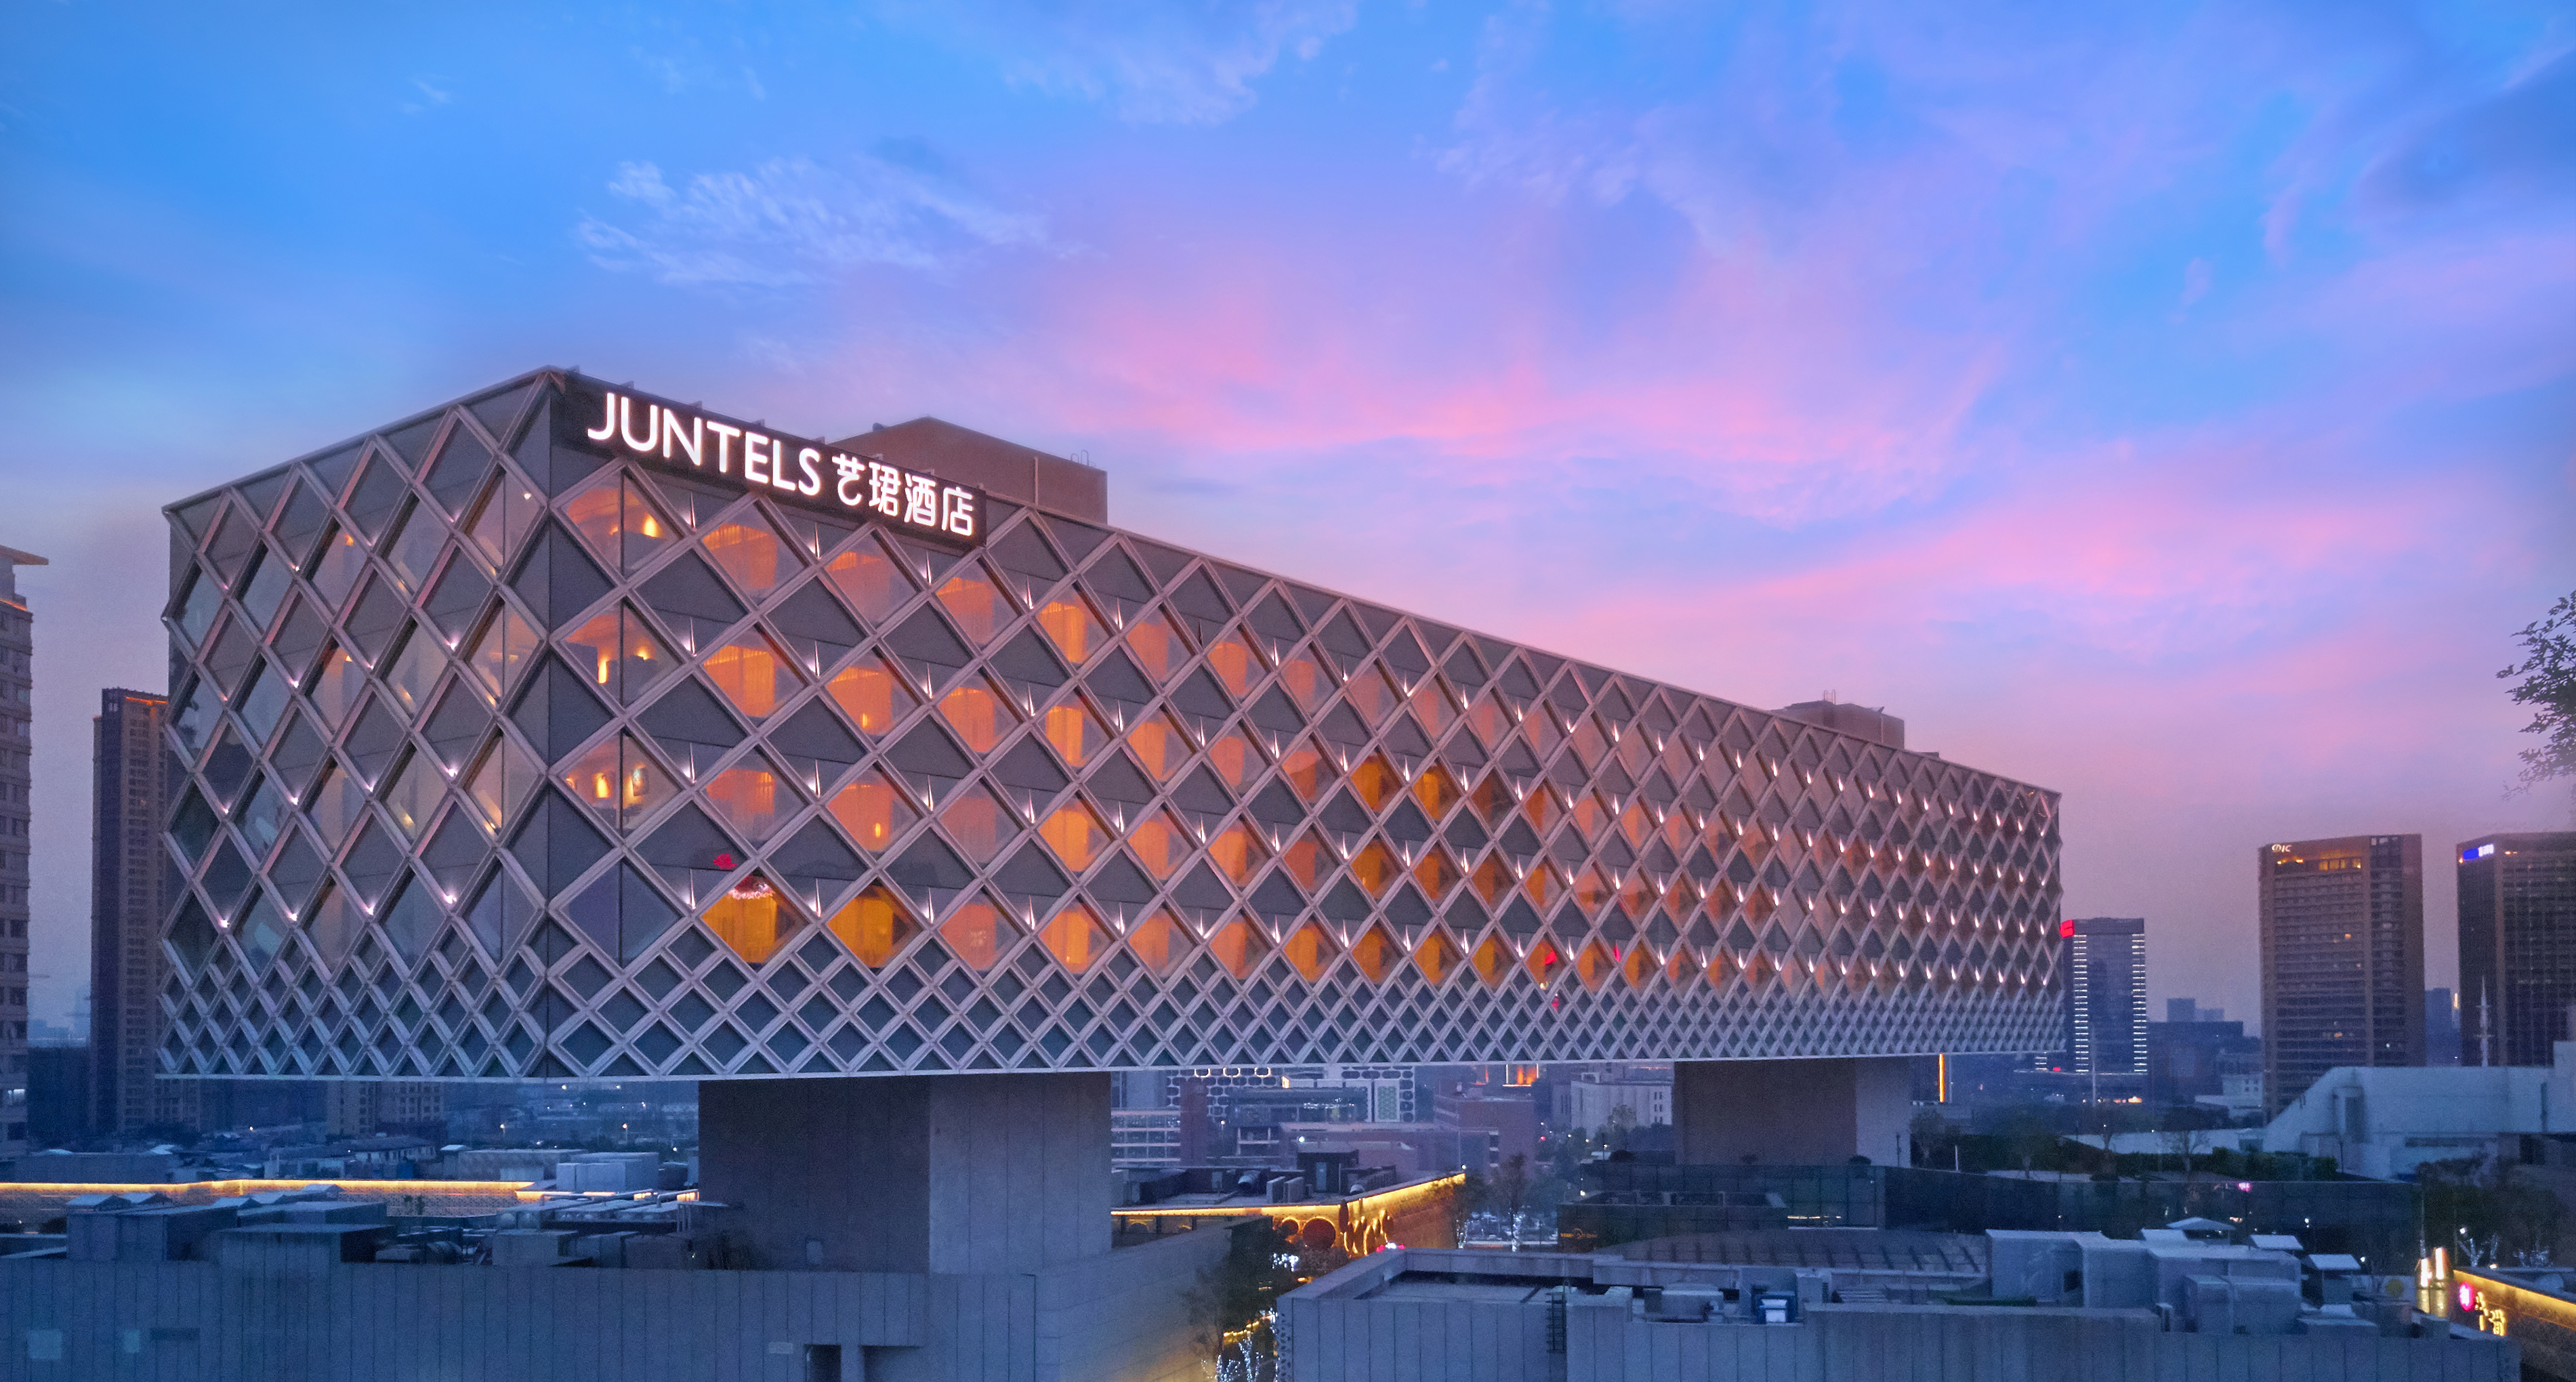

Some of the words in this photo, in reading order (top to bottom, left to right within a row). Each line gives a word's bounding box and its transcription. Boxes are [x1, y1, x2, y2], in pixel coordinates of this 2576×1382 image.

[587, 392, 821, 496] JUNTELS
[831, 453, 974, 537] 艺珺酒店
